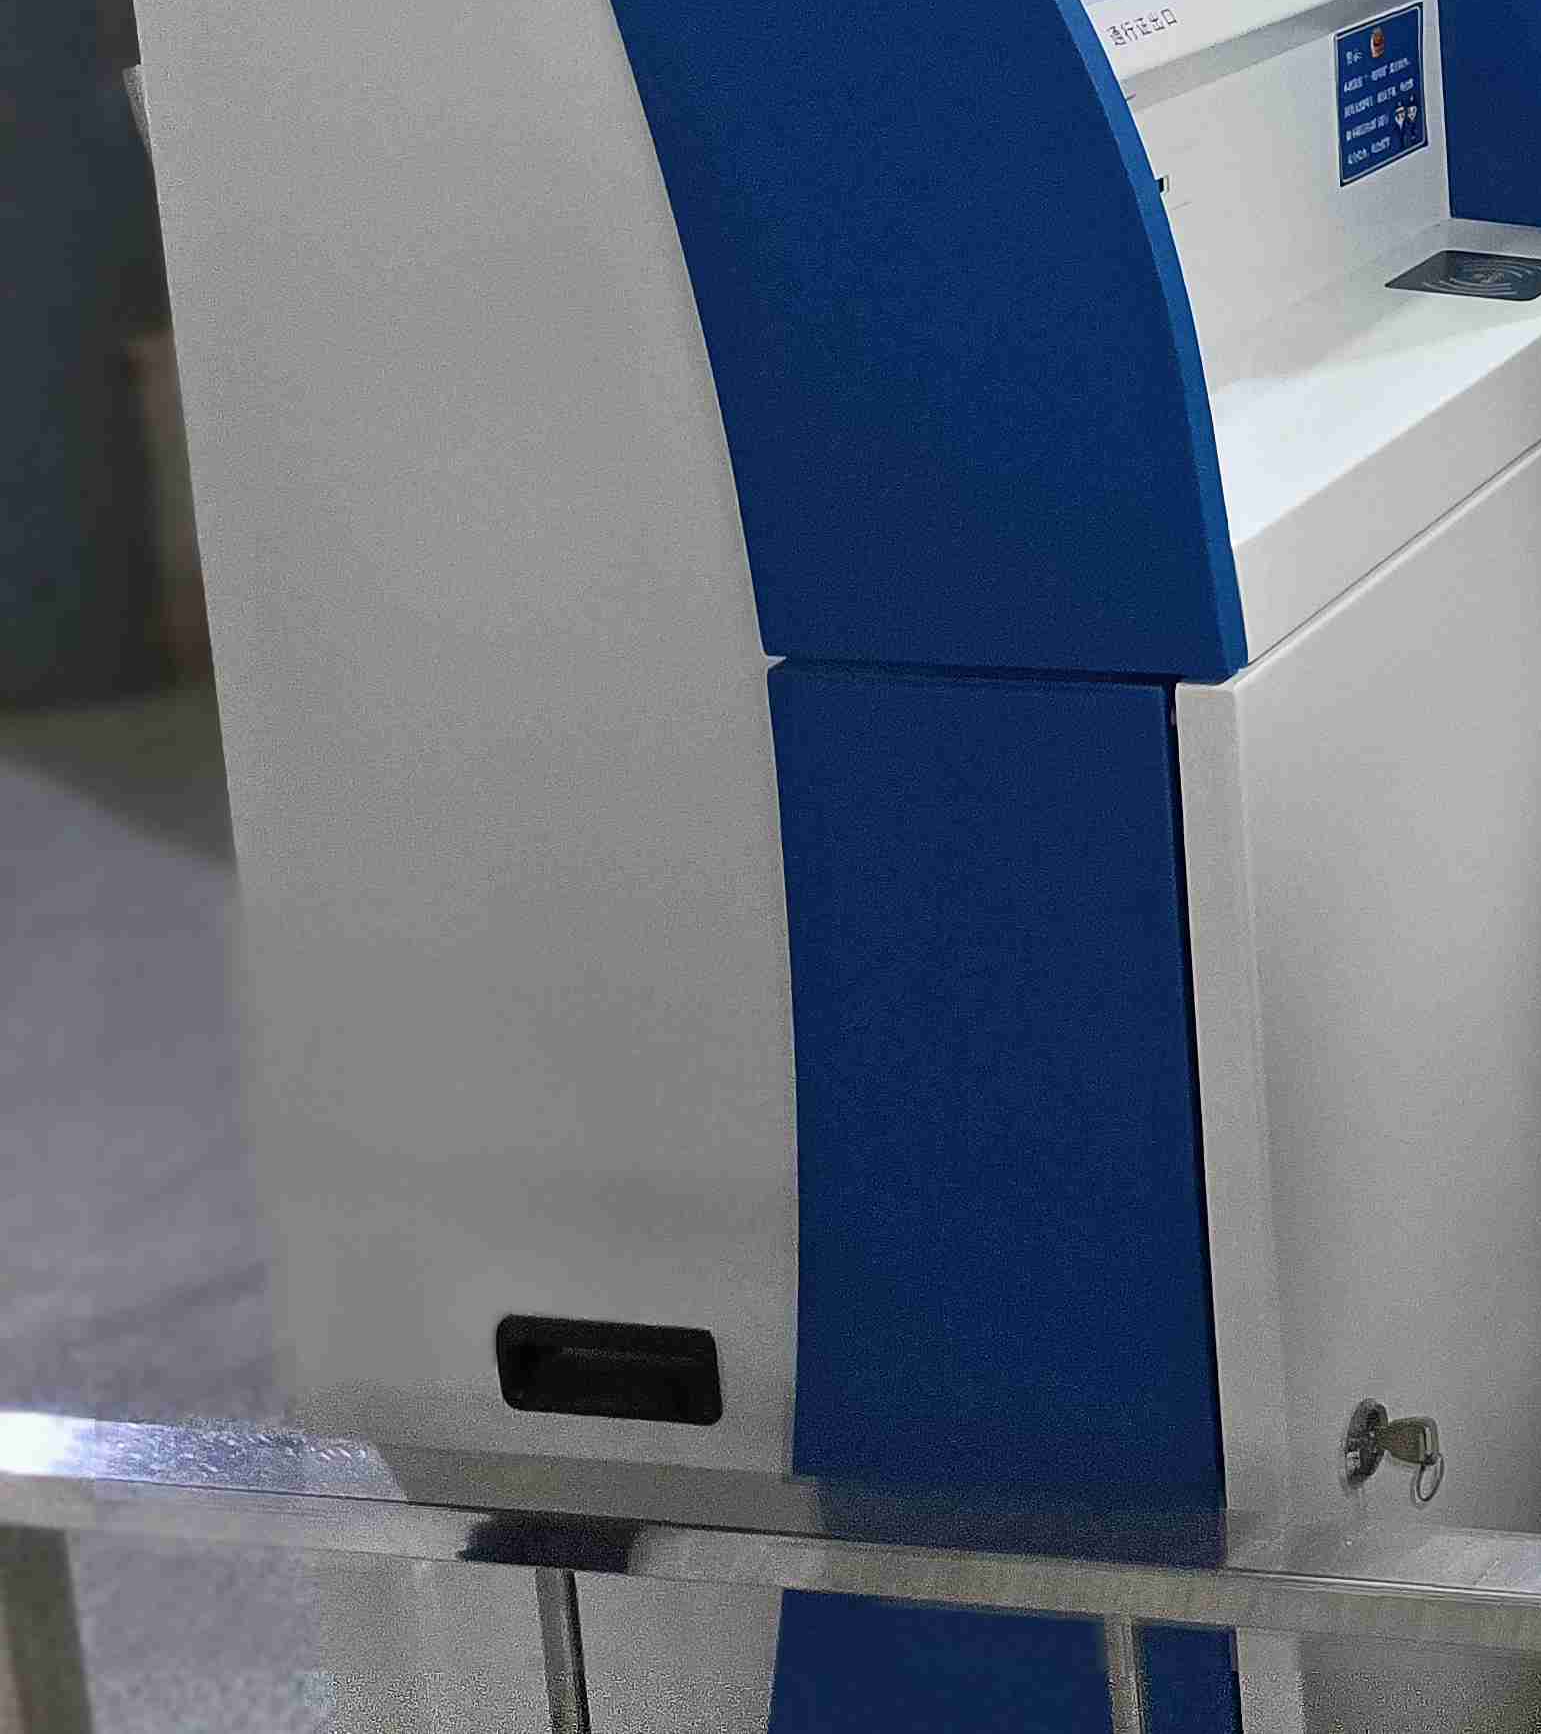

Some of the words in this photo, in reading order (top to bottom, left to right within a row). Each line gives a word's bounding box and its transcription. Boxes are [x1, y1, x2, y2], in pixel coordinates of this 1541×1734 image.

[1106, 7, 1178, 46] 通行证出口
